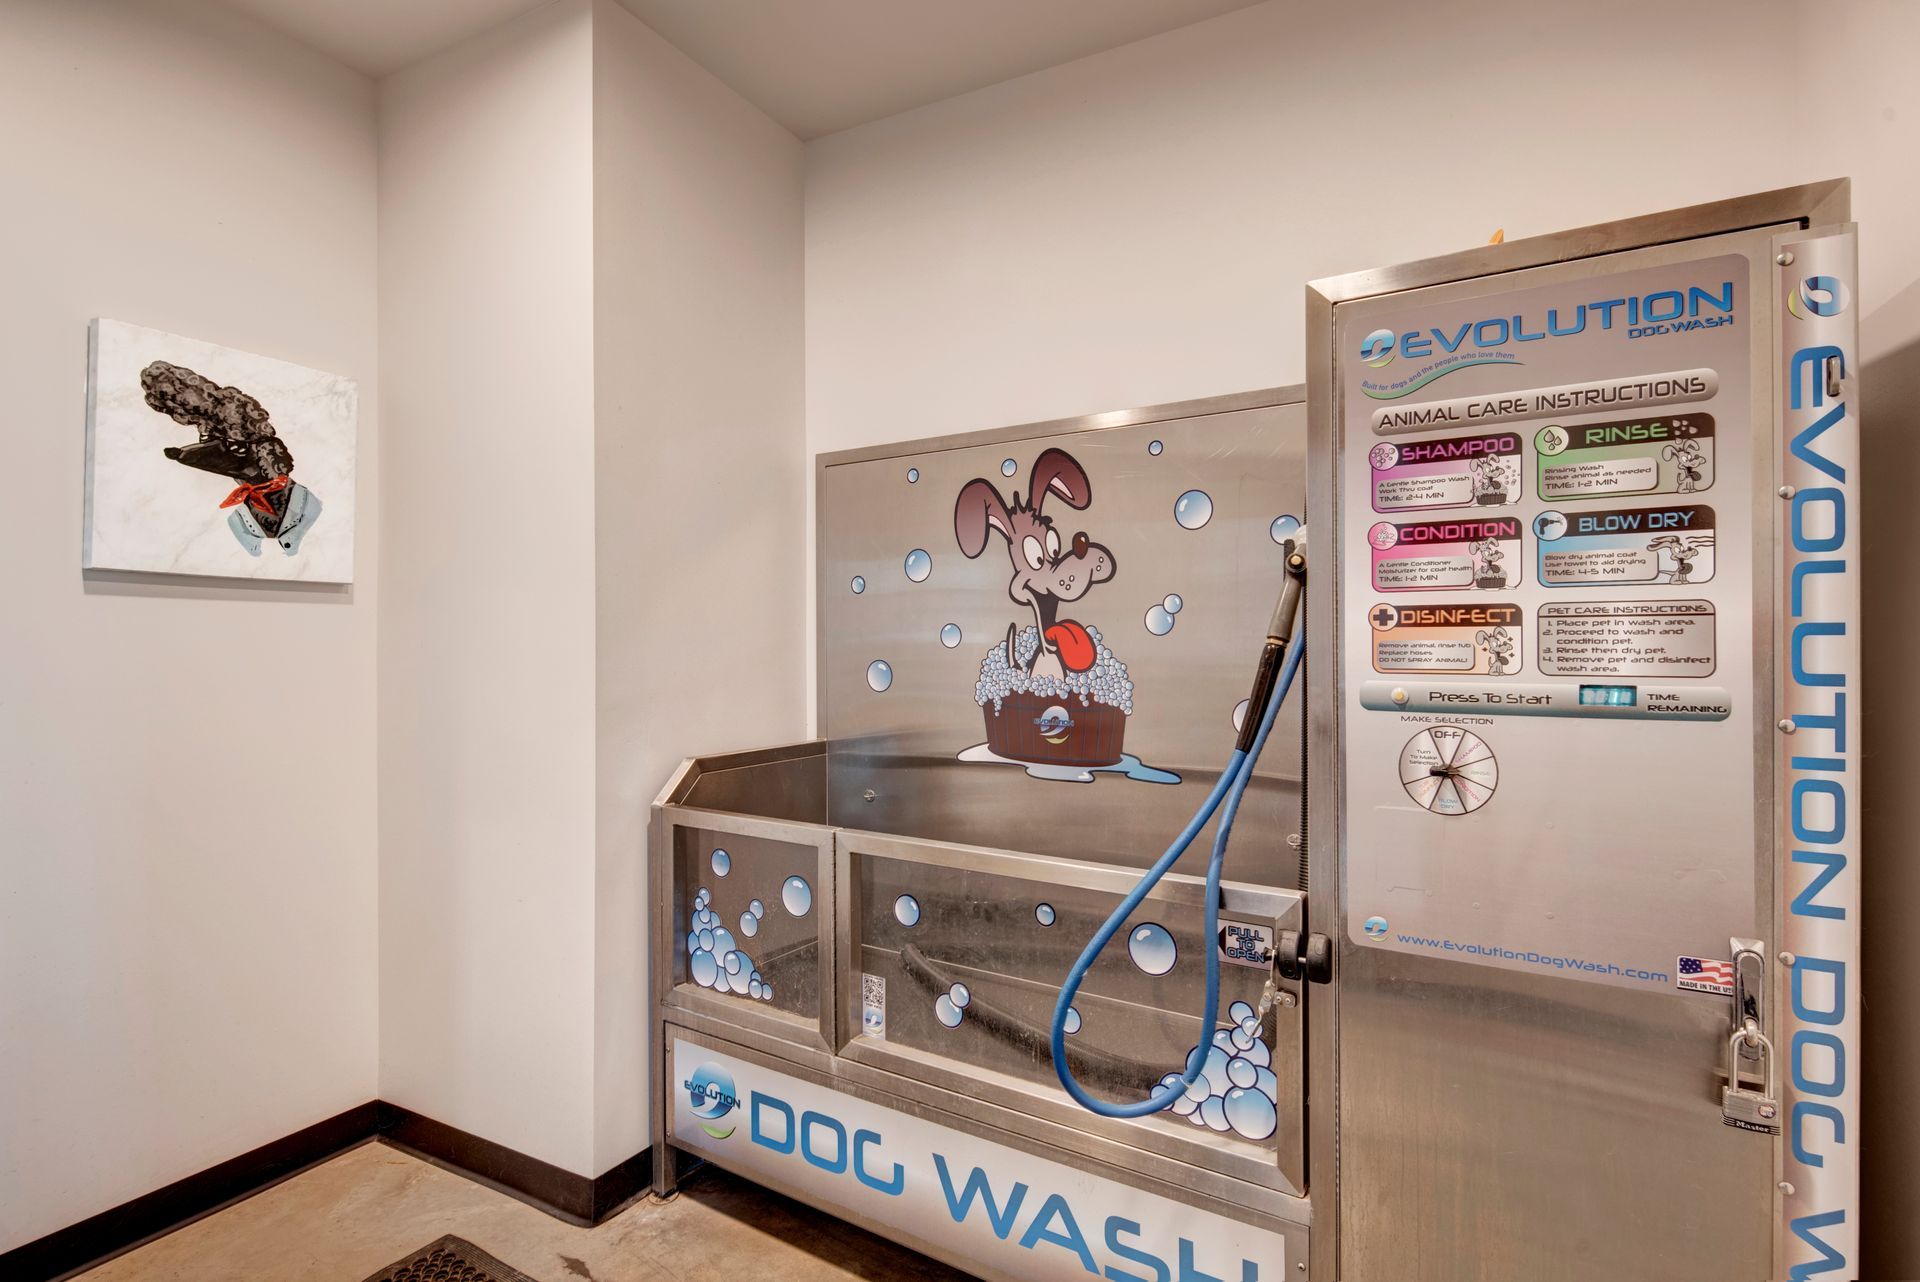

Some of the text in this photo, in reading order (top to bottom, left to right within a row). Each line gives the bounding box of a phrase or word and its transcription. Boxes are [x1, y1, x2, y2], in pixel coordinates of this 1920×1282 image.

[1400, 281, 1733, 358] EVOLUTION
[1361, 379, 1378, 391] Built
[1390, 380, 1408, 390] dogs
[1408, 371, 1422, 383] and
[1421, 365, 1434, 375] the
[1434, 356, 1459, 370] people
[1460, 352, 1477, 361] who
[1478, 351, 1494, 359] love
[1494, 351, 1515, 360] them
[1379, 377, 1706, 429] ANIMAL CARE INSTRUCTIONS
[1585, 422, 1669, 445] RINSE
[1401, 437, 1516, 461] SHAMPOO
[1544, 464, 1604, 475] Rinsing Wash
[1570, 471, 1601, 479] animal
[1616, 467, 1652, 476] needed
[1410, 477, 1446, 486] Shampoo
[1545, 481, 1575, 490] TIME:
[1595, 478, 1618, 487] MIN
[1379, 495, 1403, 503] TIME:
[1405, 493, 1423, 501] 2-4
[1578, 510, 1696, 532] BLOW DRY
[1400, 521, 1516, 542] CONDITION
[1617, 558, 1647, 566] drying
[1545, 569, 1576, 577] TIME:
[1602, 567, 1625, 575] MIN
[1379, 575, 1403, 583] TIME:
[1547, 604, 1708, 615] PET CARE INSTRUCTIONS
[1400, 608, 1517, 624] DISINFECT
[1556, 619, 1589, 627] Place
[1591, 619, 1611, 628] pet
[1629, 618, 1661, 626] wash
[1556, 628, 1605, 636] Proceed
[1607, 628, 1620, 636] to
[1790, 345, 1847, 920] EVOLUTION
[1611, 638, 1633, 647] pet.
[1556, 646, 1589, 654] Rinse
[1621, 647, 1641, 655] dry
[1644, 648, 1667, 656] pet.
[1607, 656, 1628, 664] pet
[1630, 656, 1655, 664] and
[1657, 656, 1711, 664] disinfect
[1428, 691, 1553, 705] Press To Start
[1646, 693, 1681, 702] TIME
[1647, 704, 1728, 714] REMAINING
[1400, 715, 1494, 725] MAKE SELECTION
[1434, 730, 1462, 739] OFF
[1227, 925, 1265, 943] PULL
[1236, 937, 1256, 951] TO
[1226, 946, 1265, 964] OPEN
[1397, 934, 1668, 983] www.EvolutionDogWash.com
[1679, 980, 1698, 989] MADE
[1708, 984, 1721, 992] THE
[1790, 955, 1847, 1168] DOG
[683, 1080, 742, 1110] EVOLUTION
[1735, 1120, 1770, 1133] Master
[750, 1089, 905, 1196] DOG
